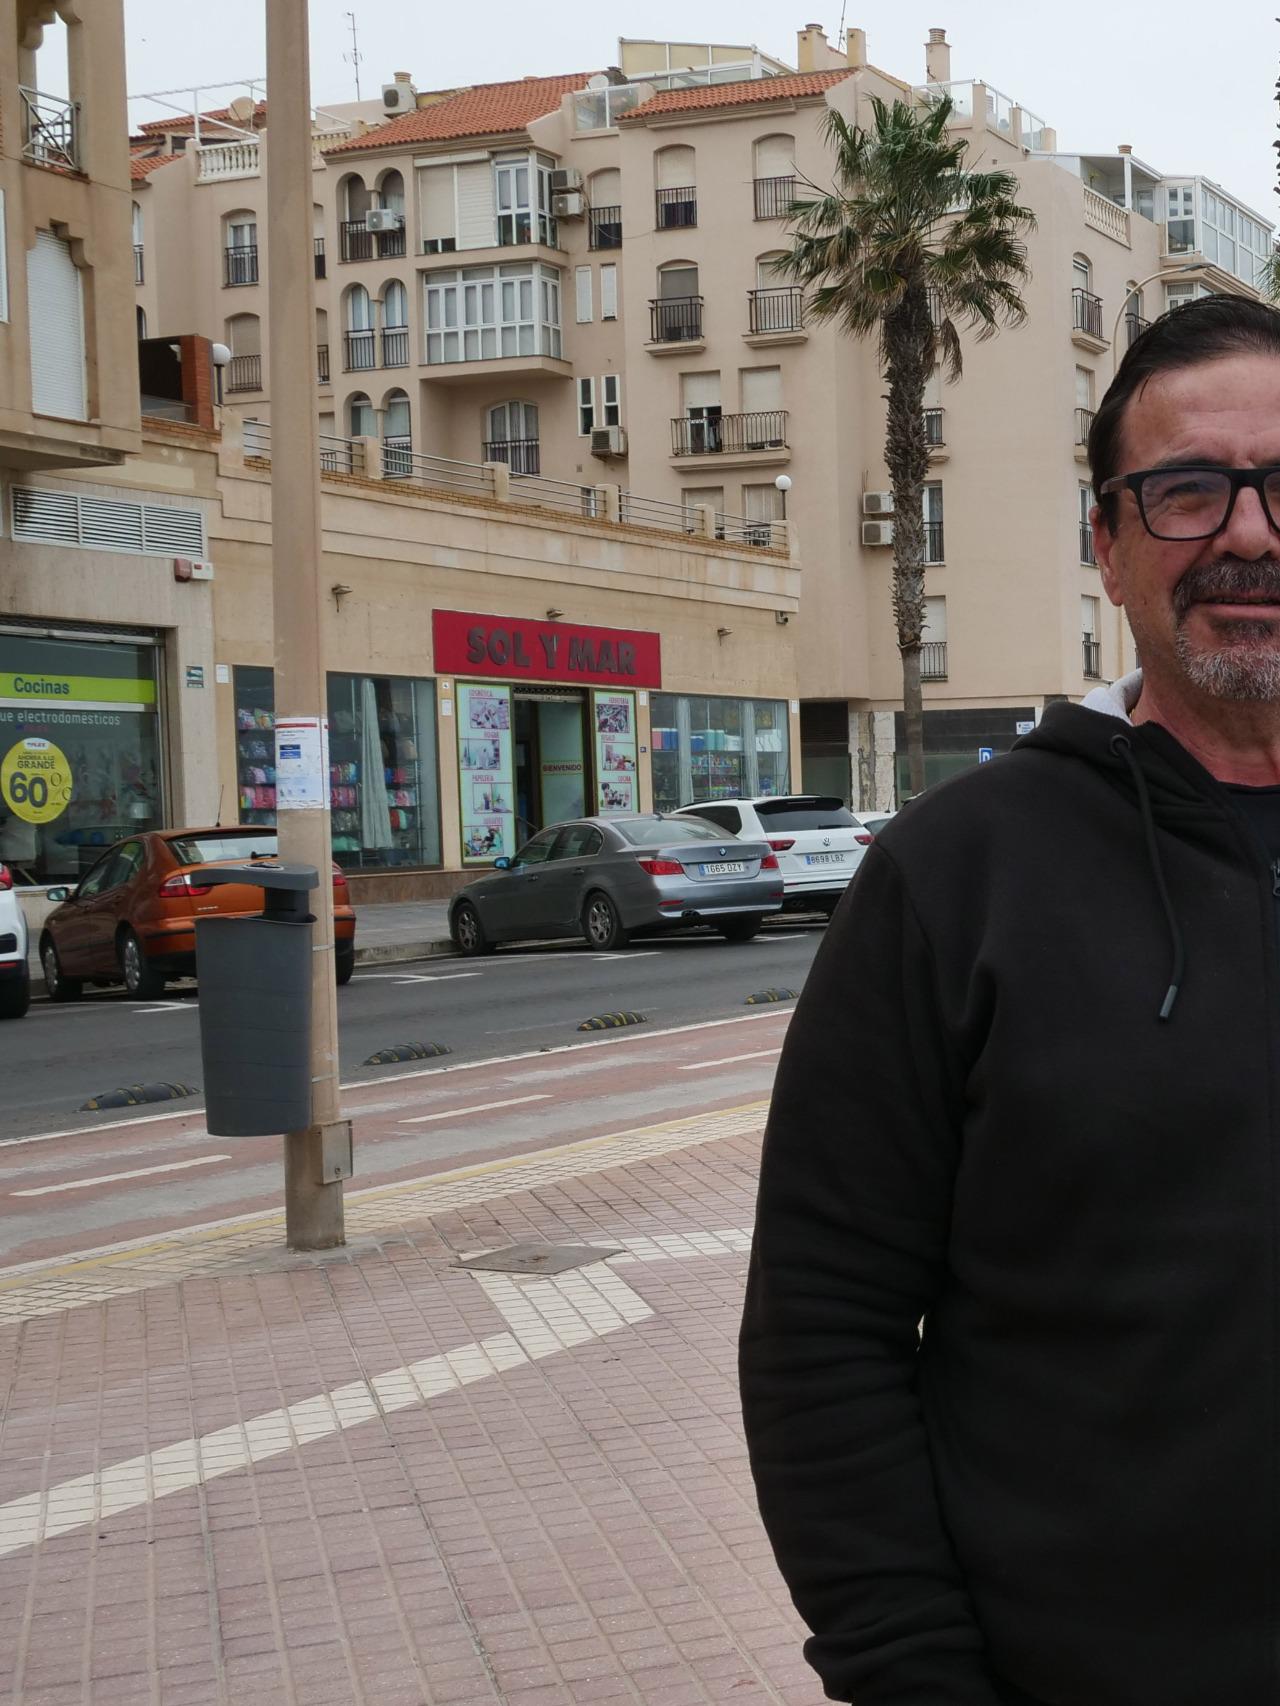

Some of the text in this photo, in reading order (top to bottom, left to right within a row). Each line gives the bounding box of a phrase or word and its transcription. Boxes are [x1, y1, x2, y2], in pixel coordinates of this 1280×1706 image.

[467, 626, 636, 675] SOL Y MAR
[14, 677, 70, 695] Cocinas
[0, 710, 121, 726] ue electrodomésticos
[17, 760, 56, 769] GRANDE
[543, 764, 582, 772] BIENVENIDO
